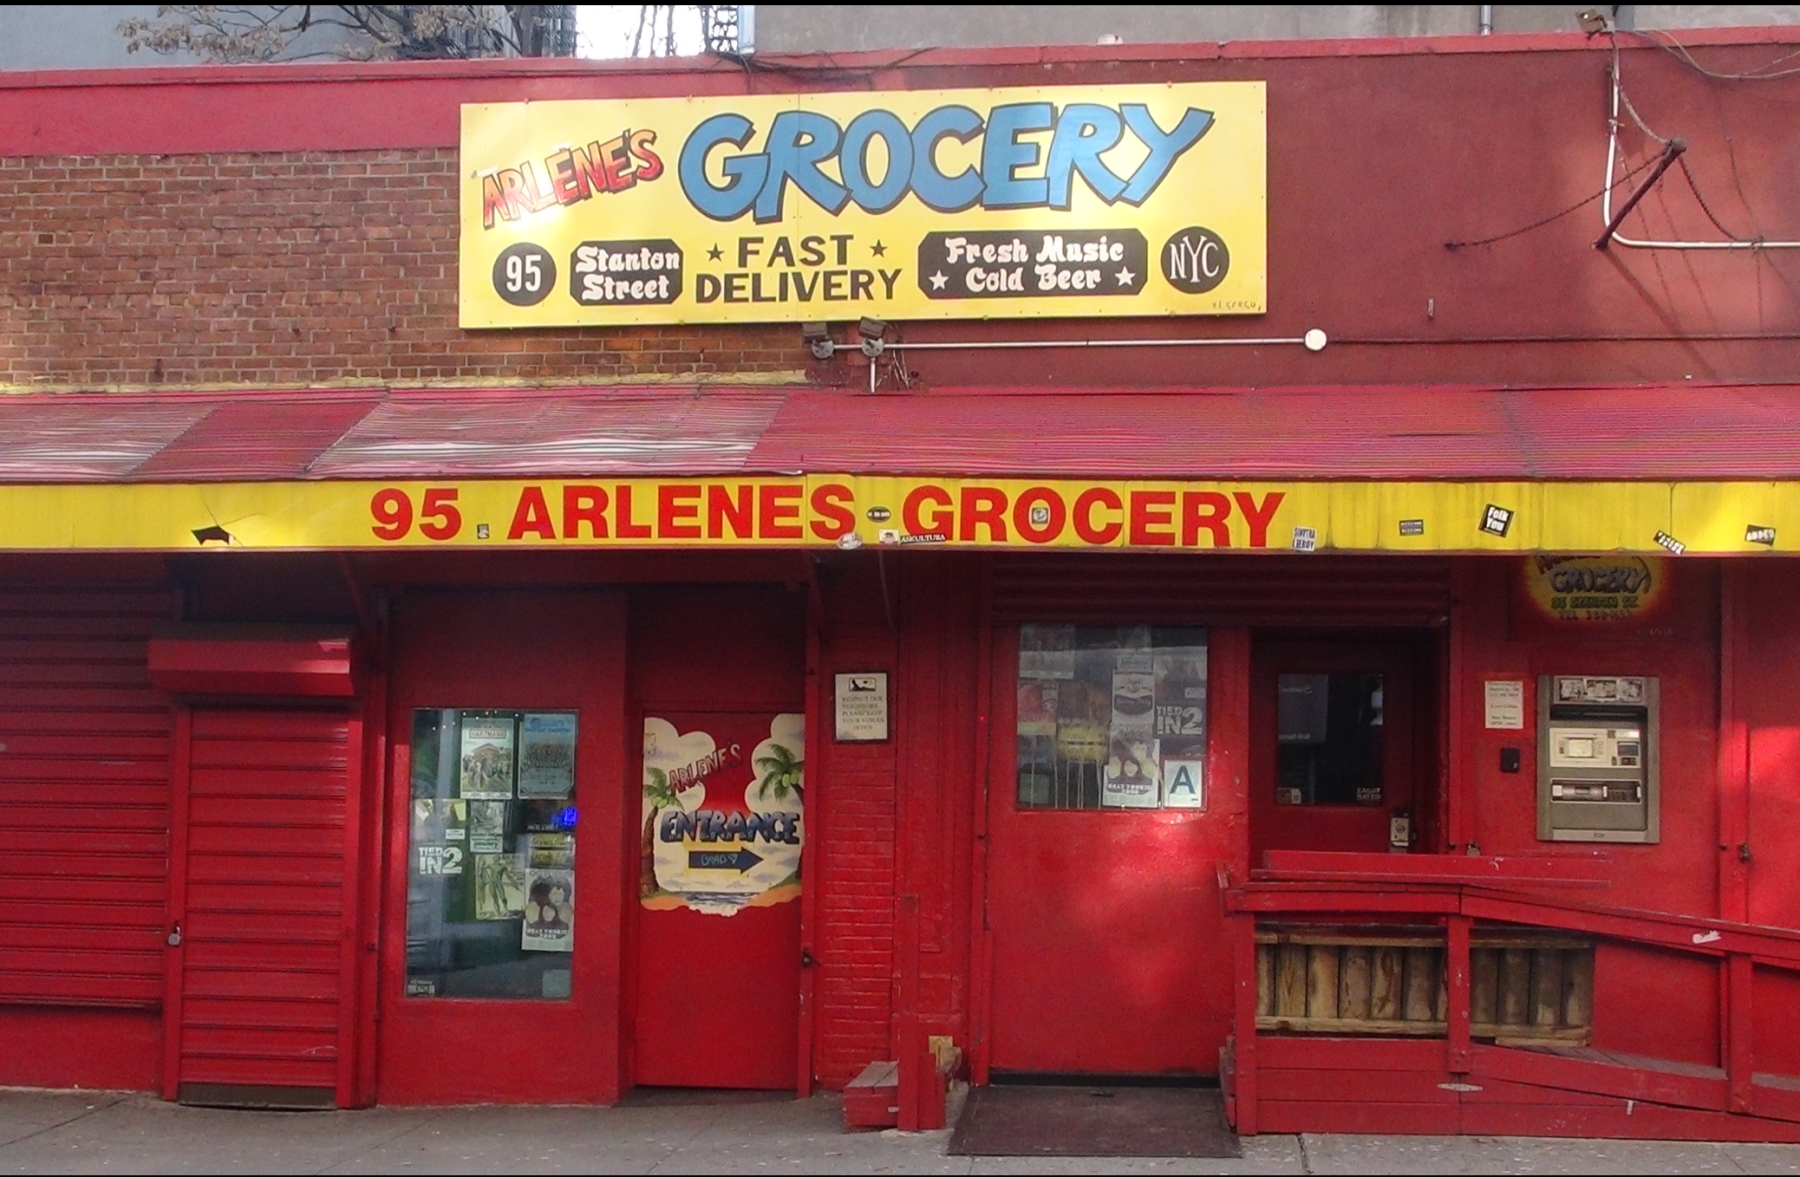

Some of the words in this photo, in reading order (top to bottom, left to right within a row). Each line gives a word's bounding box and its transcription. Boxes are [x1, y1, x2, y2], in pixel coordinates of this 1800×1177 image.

[483, 128, 664, 231] ARLENE'S
[678, 101, 1216, 224] GROCERY
[575, 245, 680, 272] Stanton
[738, 234, 854, 268] FAST
[944, 237, 1029, 264] Fresh
[1035, 235, 1124, 263] Music
[1169, 235, 1220, 283] NYC
[505, 254, 542, 293] 95
[582, 274, 670, 301] Street
[695, 268, 903, 304] DELIVERY
[965, 266, 1025, 293] Cold
[1034, 264, 1102, 291] Beer
[370, 487, 463, 541] 95
[507, 483, 856, 541] ARLENES
[902, 485, 1286, 547] GROCERY
[1169, 765, 1196, 794] A
[661, 810, 801, 845] ENTRANCE
